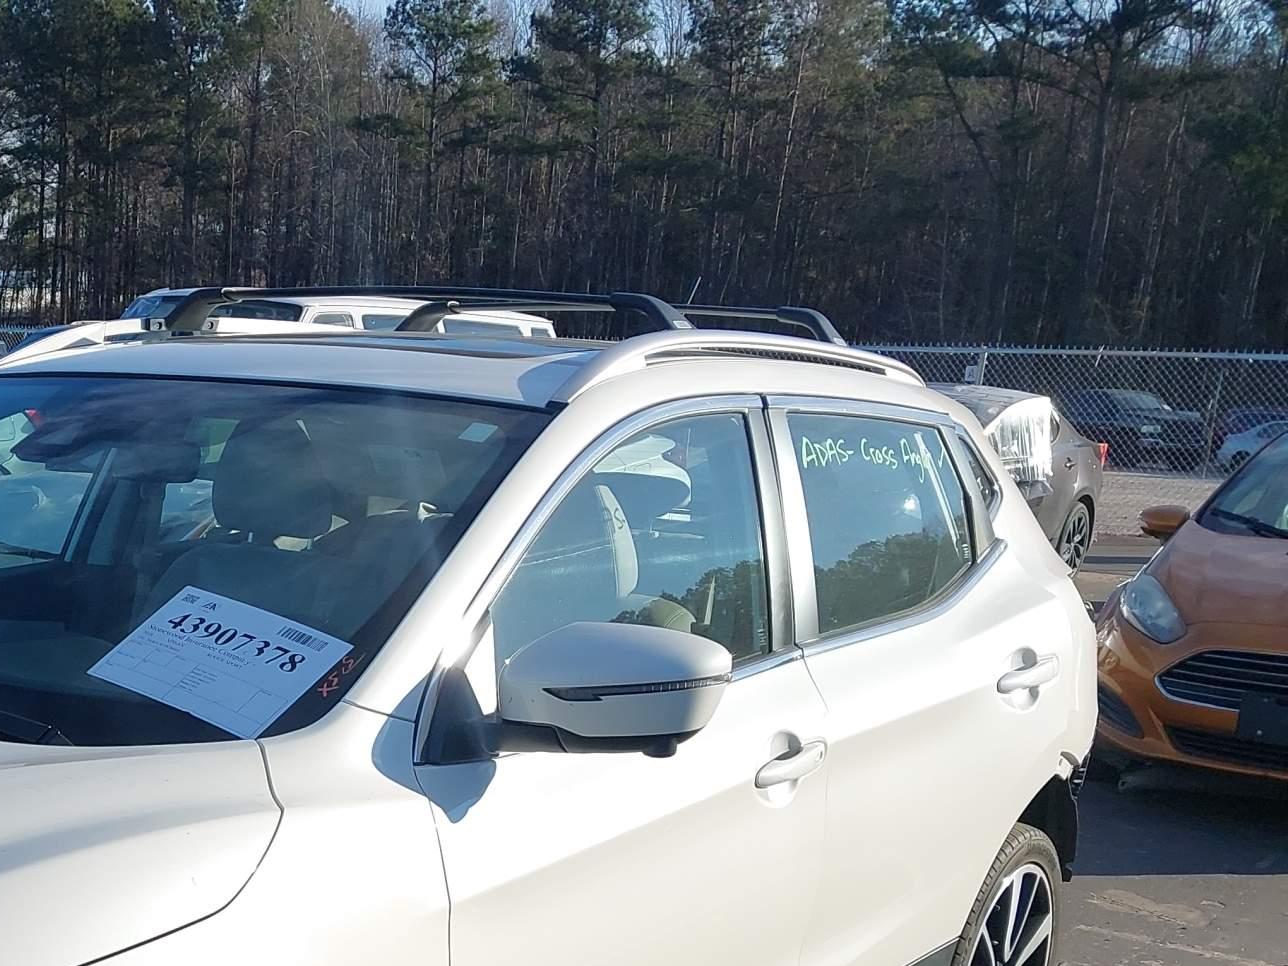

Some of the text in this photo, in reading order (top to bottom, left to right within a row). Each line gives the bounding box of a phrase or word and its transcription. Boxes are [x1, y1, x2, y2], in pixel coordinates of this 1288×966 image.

[801, 436, 854, 468] ADAS-
[860, 437, 898, 470] Cross
[167, 612, 307, 673] 43907378
